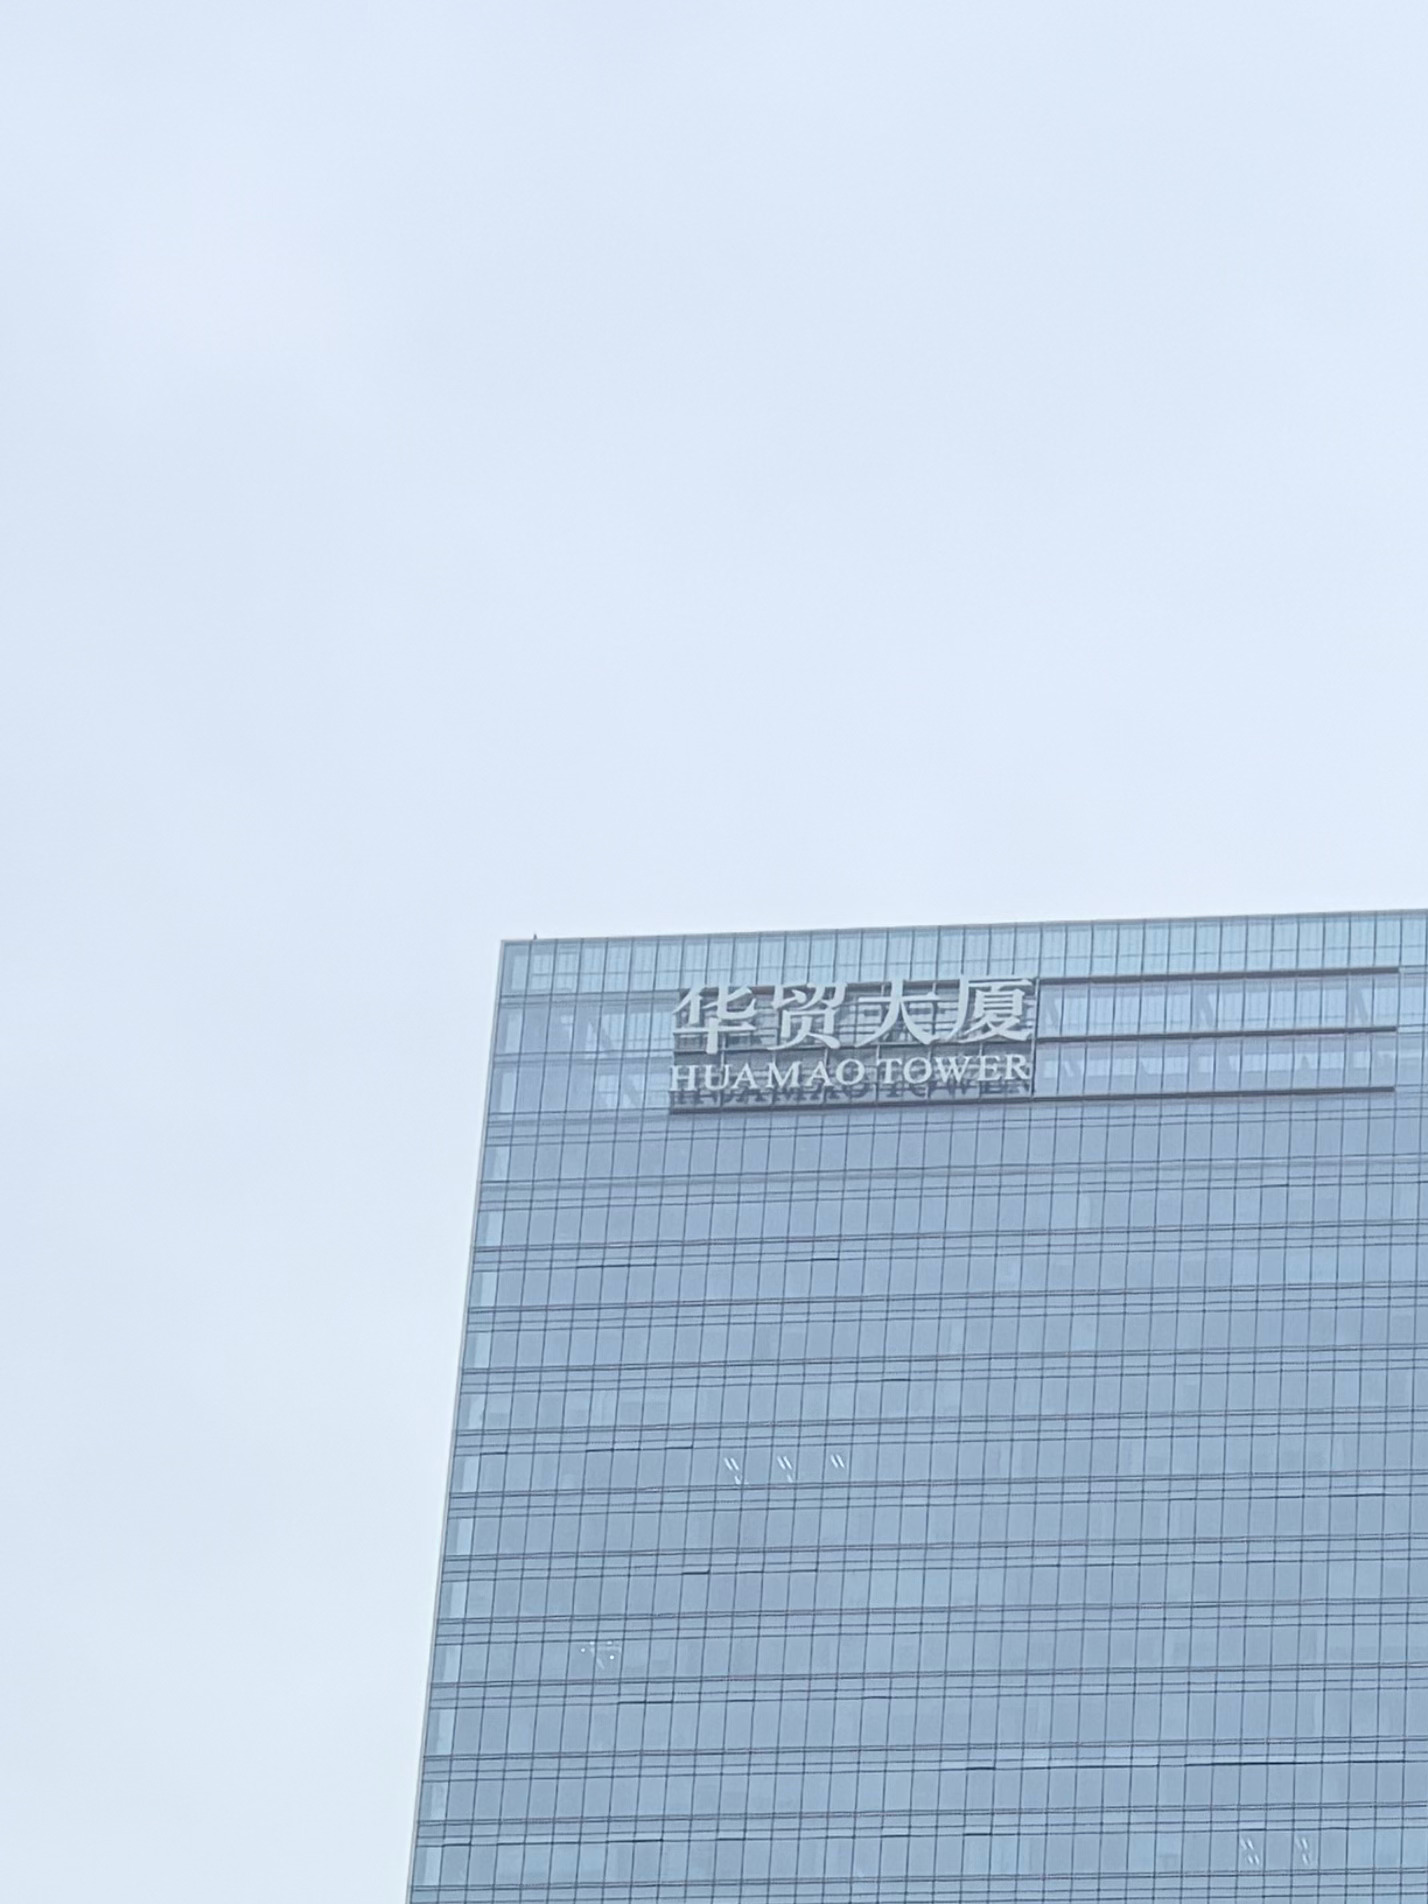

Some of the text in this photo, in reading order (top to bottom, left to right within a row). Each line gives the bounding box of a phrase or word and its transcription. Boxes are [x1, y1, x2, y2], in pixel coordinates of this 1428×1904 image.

[671, 974, 1034, 1055] 华贸大厦
[670, 1053, 1030, 1092] HUAMAO TOWER
